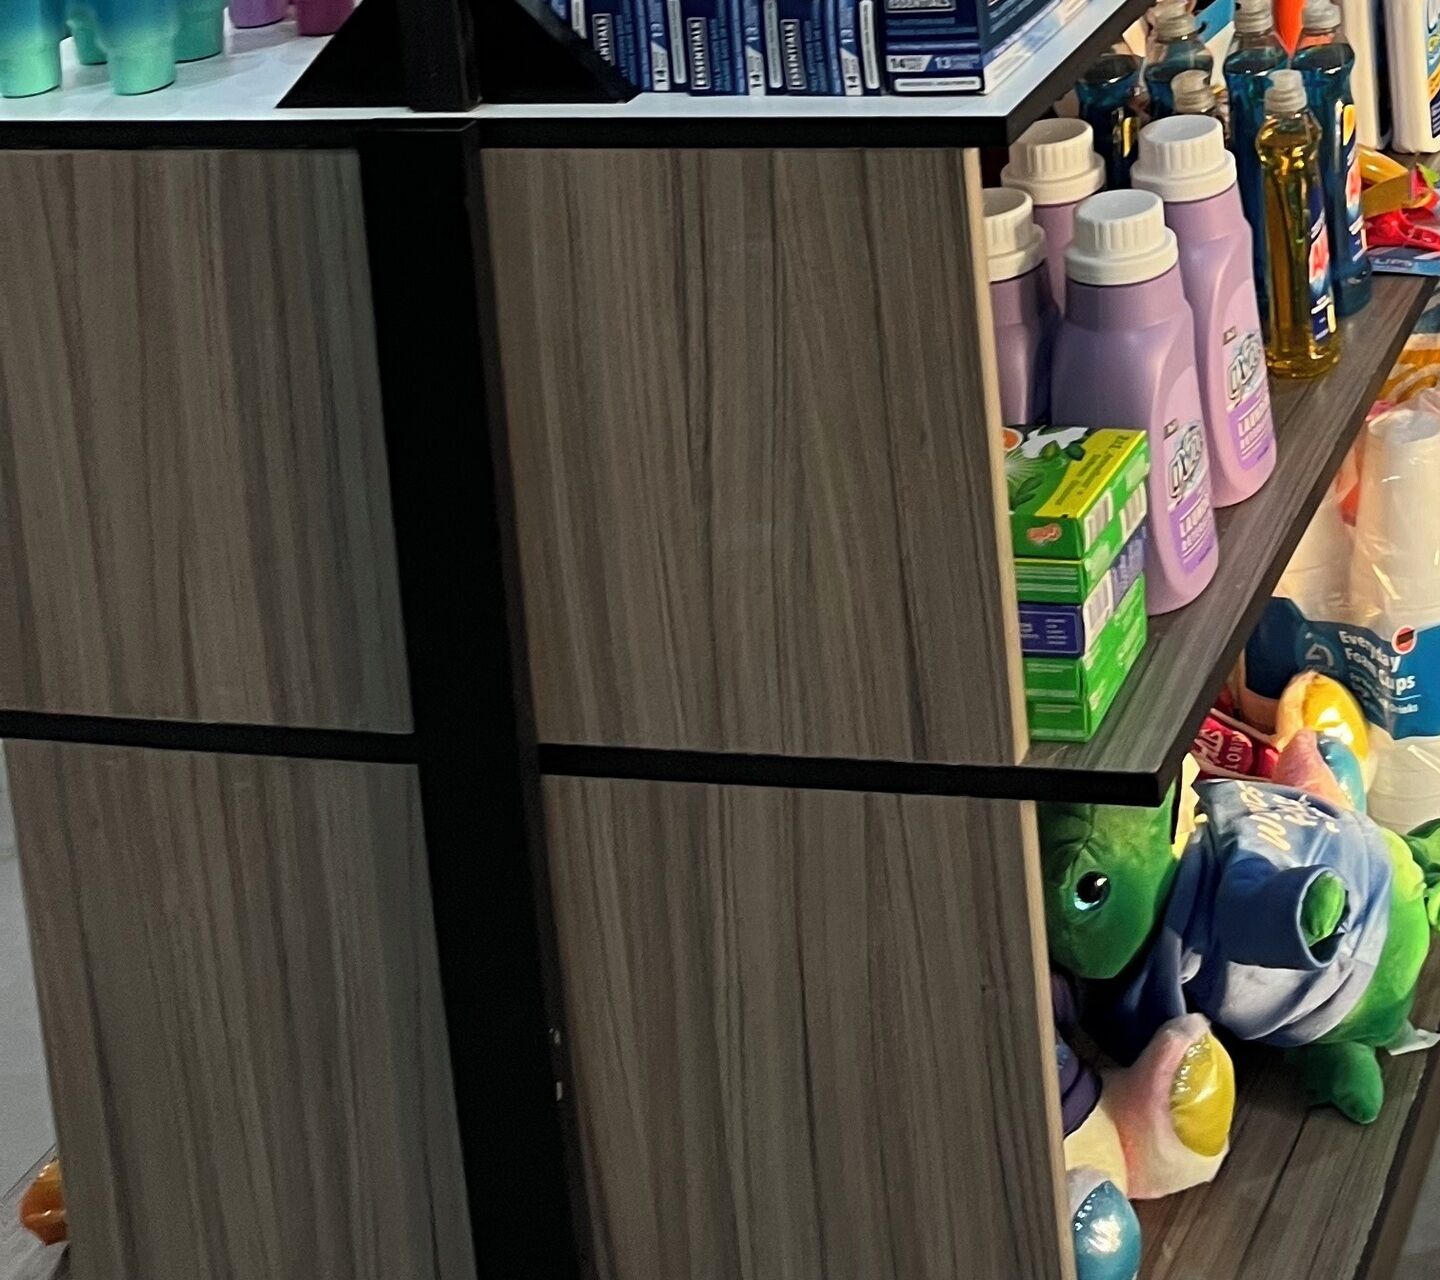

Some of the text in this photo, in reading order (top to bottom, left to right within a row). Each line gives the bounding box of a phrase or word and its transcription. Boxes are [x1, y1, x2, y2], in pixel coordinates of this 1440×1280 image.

[691, 19, 707, 87] ESSENTIALS
[783, 24, 801, 88] ESSENTIALS
[1338, 630, 1401, 673] Everyday
[1378, 668, 1416, 696] Cups
